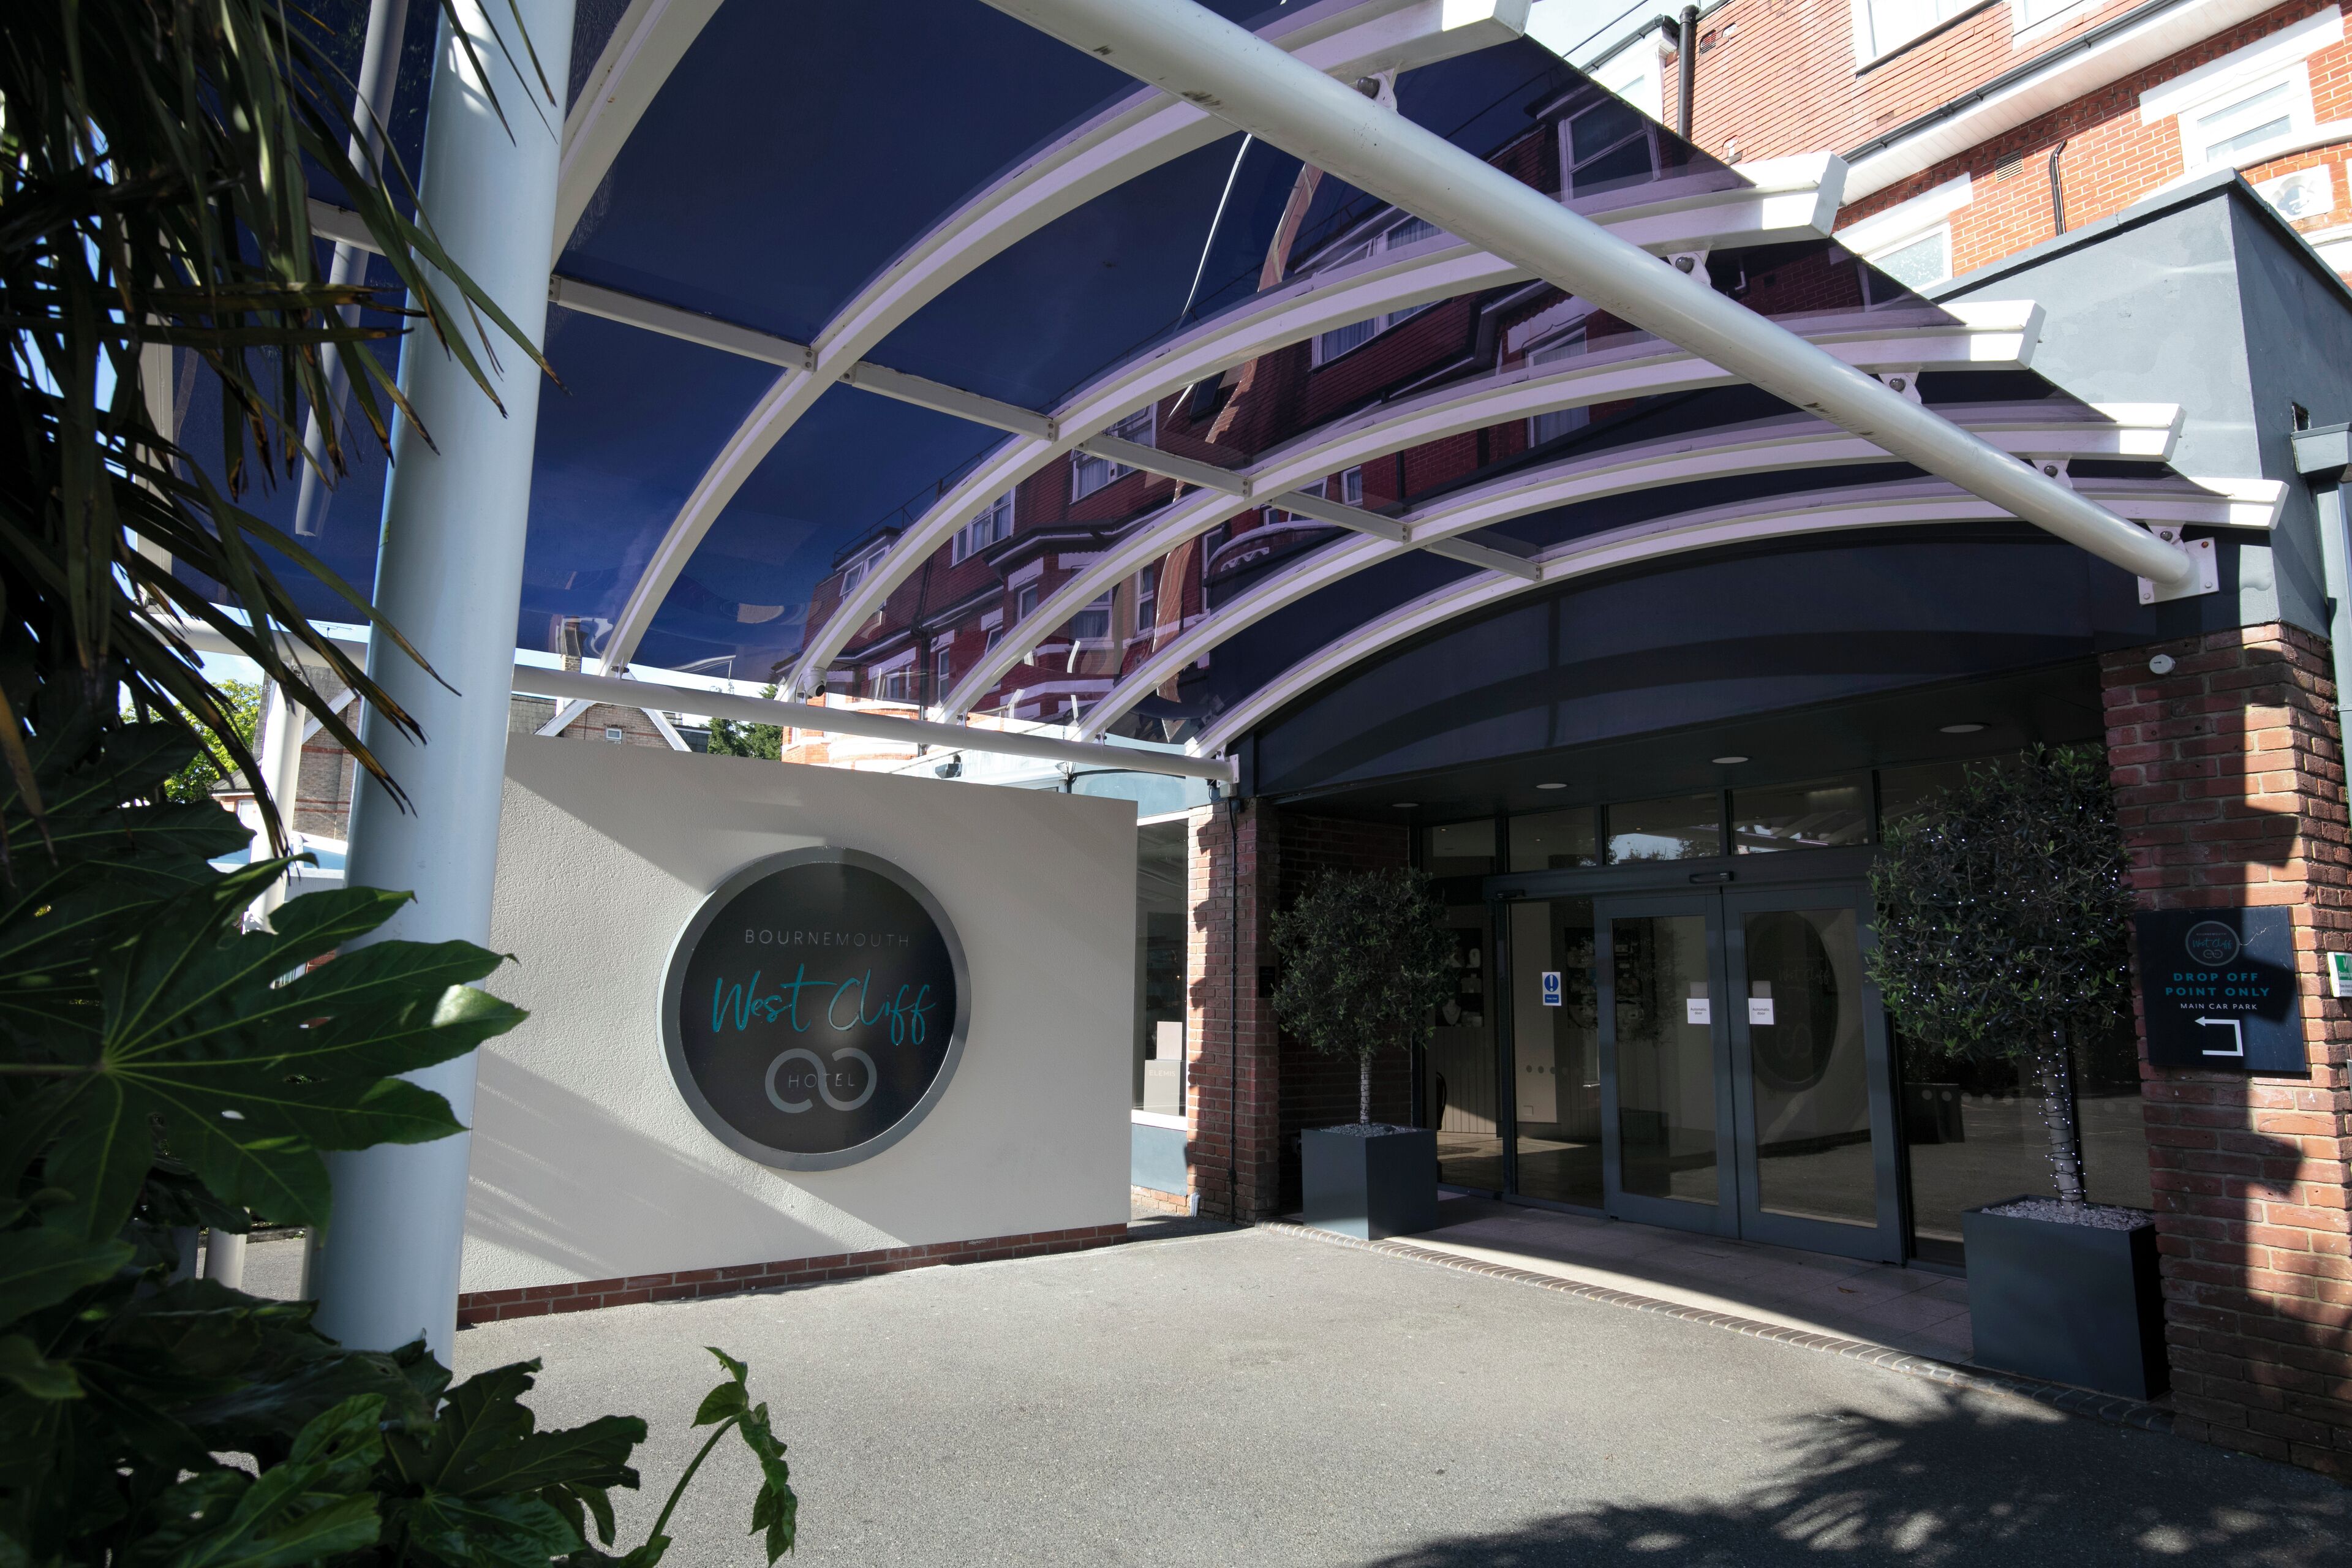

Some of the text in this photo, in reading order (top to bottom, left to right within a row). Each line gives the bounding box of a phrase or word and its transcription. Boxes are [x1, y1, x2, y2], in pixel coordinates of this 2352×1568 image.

[745, 929, 909, 947] BOURNEMOUTH
[2173, 972, 2258, 982] DROP OFF
[2165, 987, 2269, 997] POINT ONLY
[711, 963, 936, 1046] West Cliff
[788, 1072, 856, 1088] HOTEL
[1148, 1069, 1176, 1078] ELEMIS
